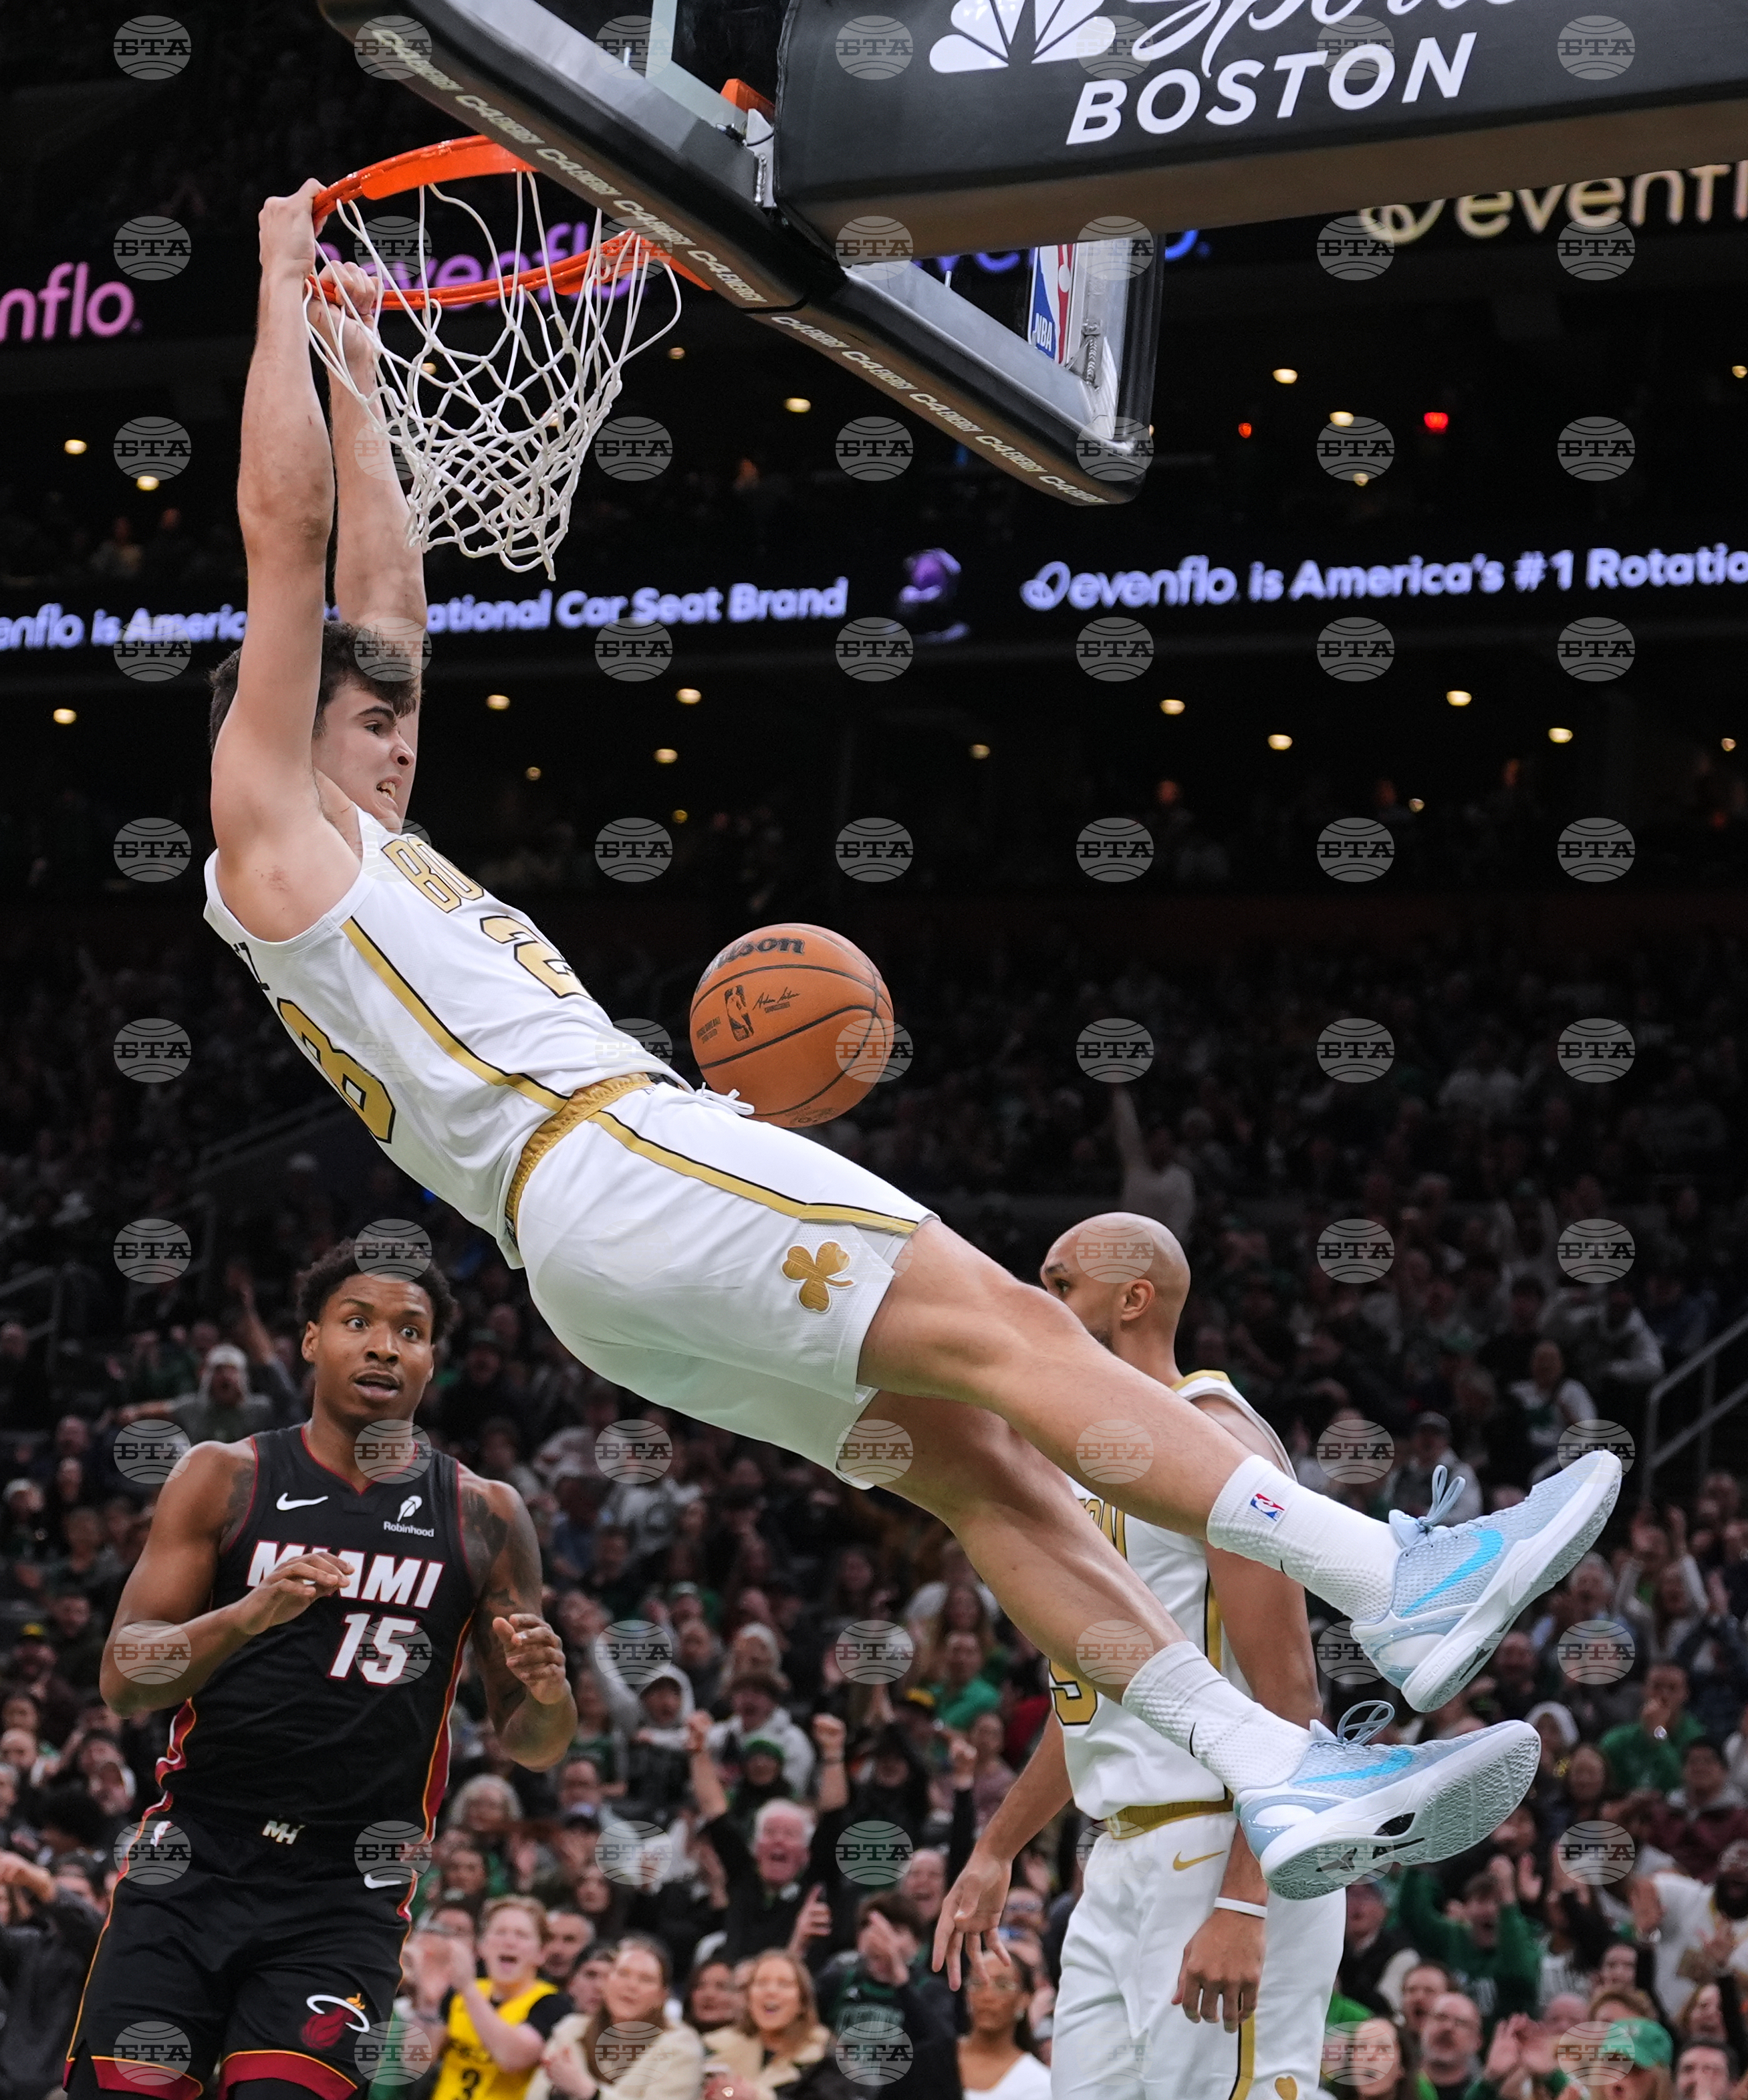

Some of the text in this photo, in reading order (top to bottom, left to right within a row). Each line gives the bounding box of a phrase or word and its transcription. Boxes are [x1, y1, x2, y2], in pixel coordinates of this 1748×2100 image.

[1066, 31, 1478, 146] BOSTON
[1033, 312, 1054, 352] NBA
[1070, 542, 1748, 610] evenflo is America's #1 Rotatio
[91, 608, 123, 646] is
[123, 604, 248, 645] Americ
[426, 588, 553, 634] ational
[555, 589, 628, 630] Car
[630, 586, 723, 626] Seat
[727, 576, 849, 624] Brand
[479, 915, 596, 1002] 2
[383, 1520, 434, 1538] Robinhood
[247, 1540, 446, 1609] MAMI
[326, 1611, 420, 1687] 15
